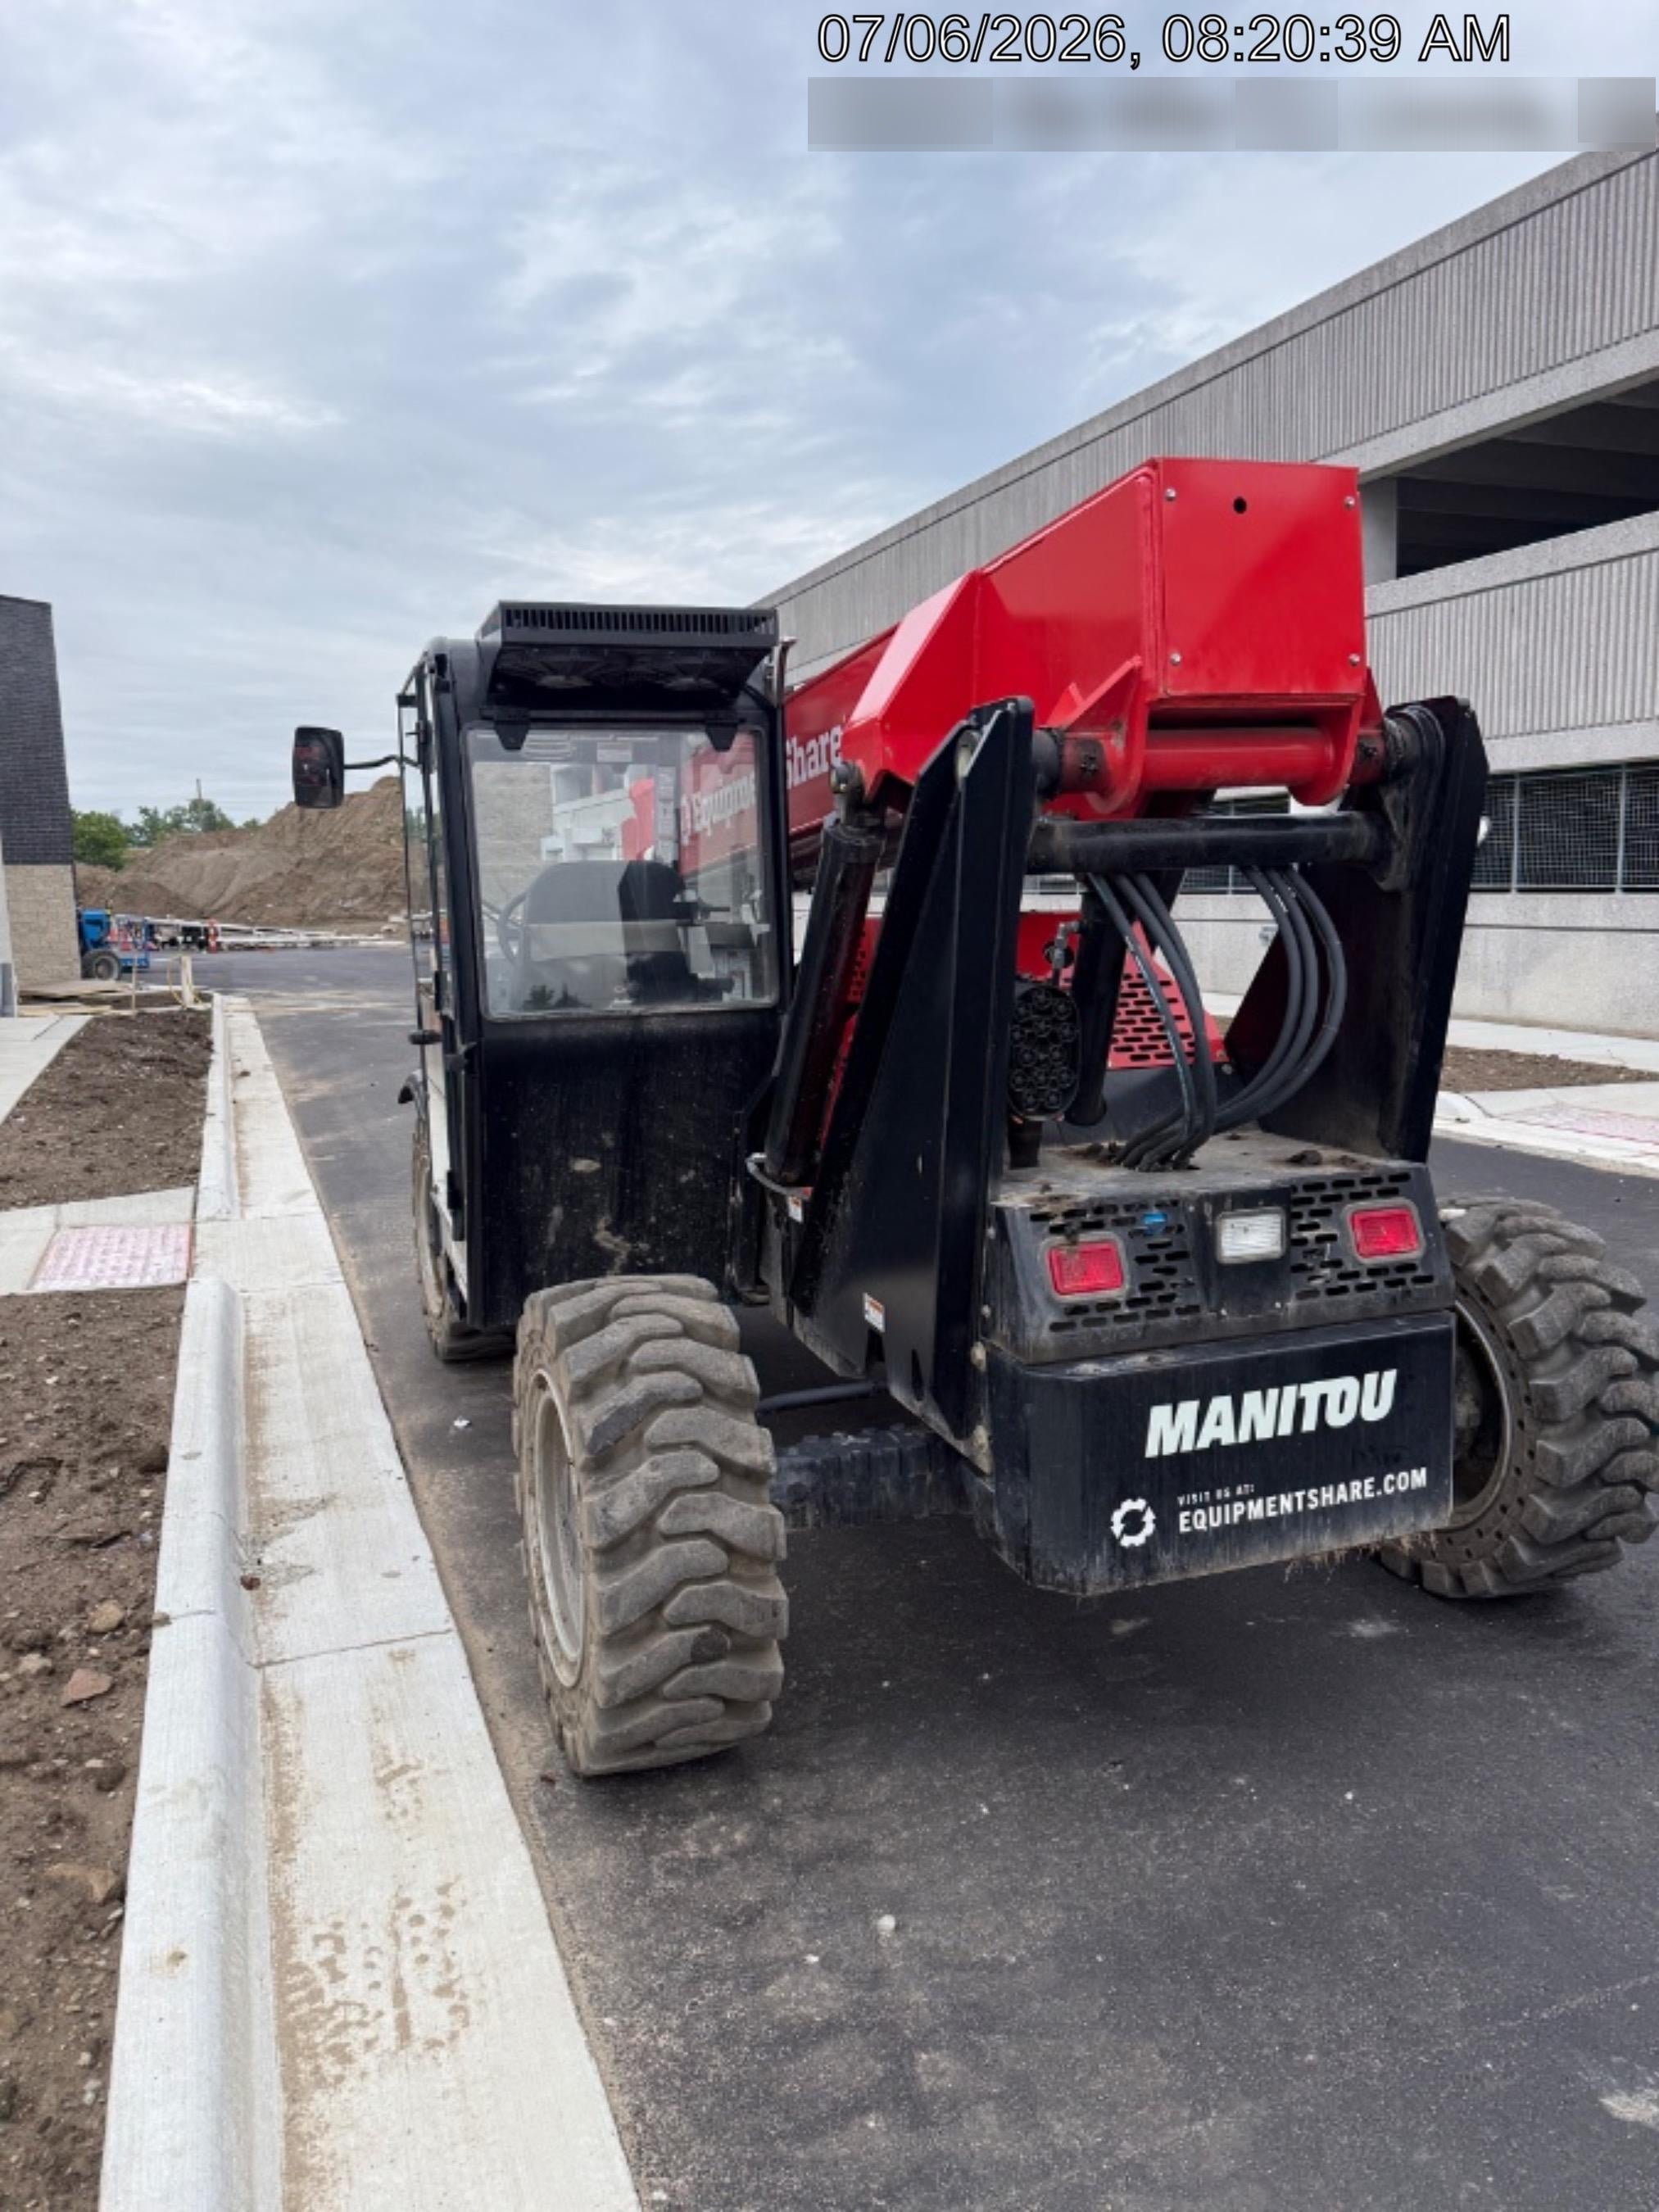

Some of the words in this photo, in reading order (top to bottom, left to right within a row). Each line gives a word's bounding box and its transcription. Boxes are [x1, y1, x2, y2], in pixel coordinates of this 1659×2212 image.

[1145, 1368, 1398, 1458] MANITOU
[1176, 1490, 1211, 1507] VISIT
[1216, 1486, 1231, 1500] US
[1178, 1466, 1427, 1534] EQUIPMENTSHARE.COM
